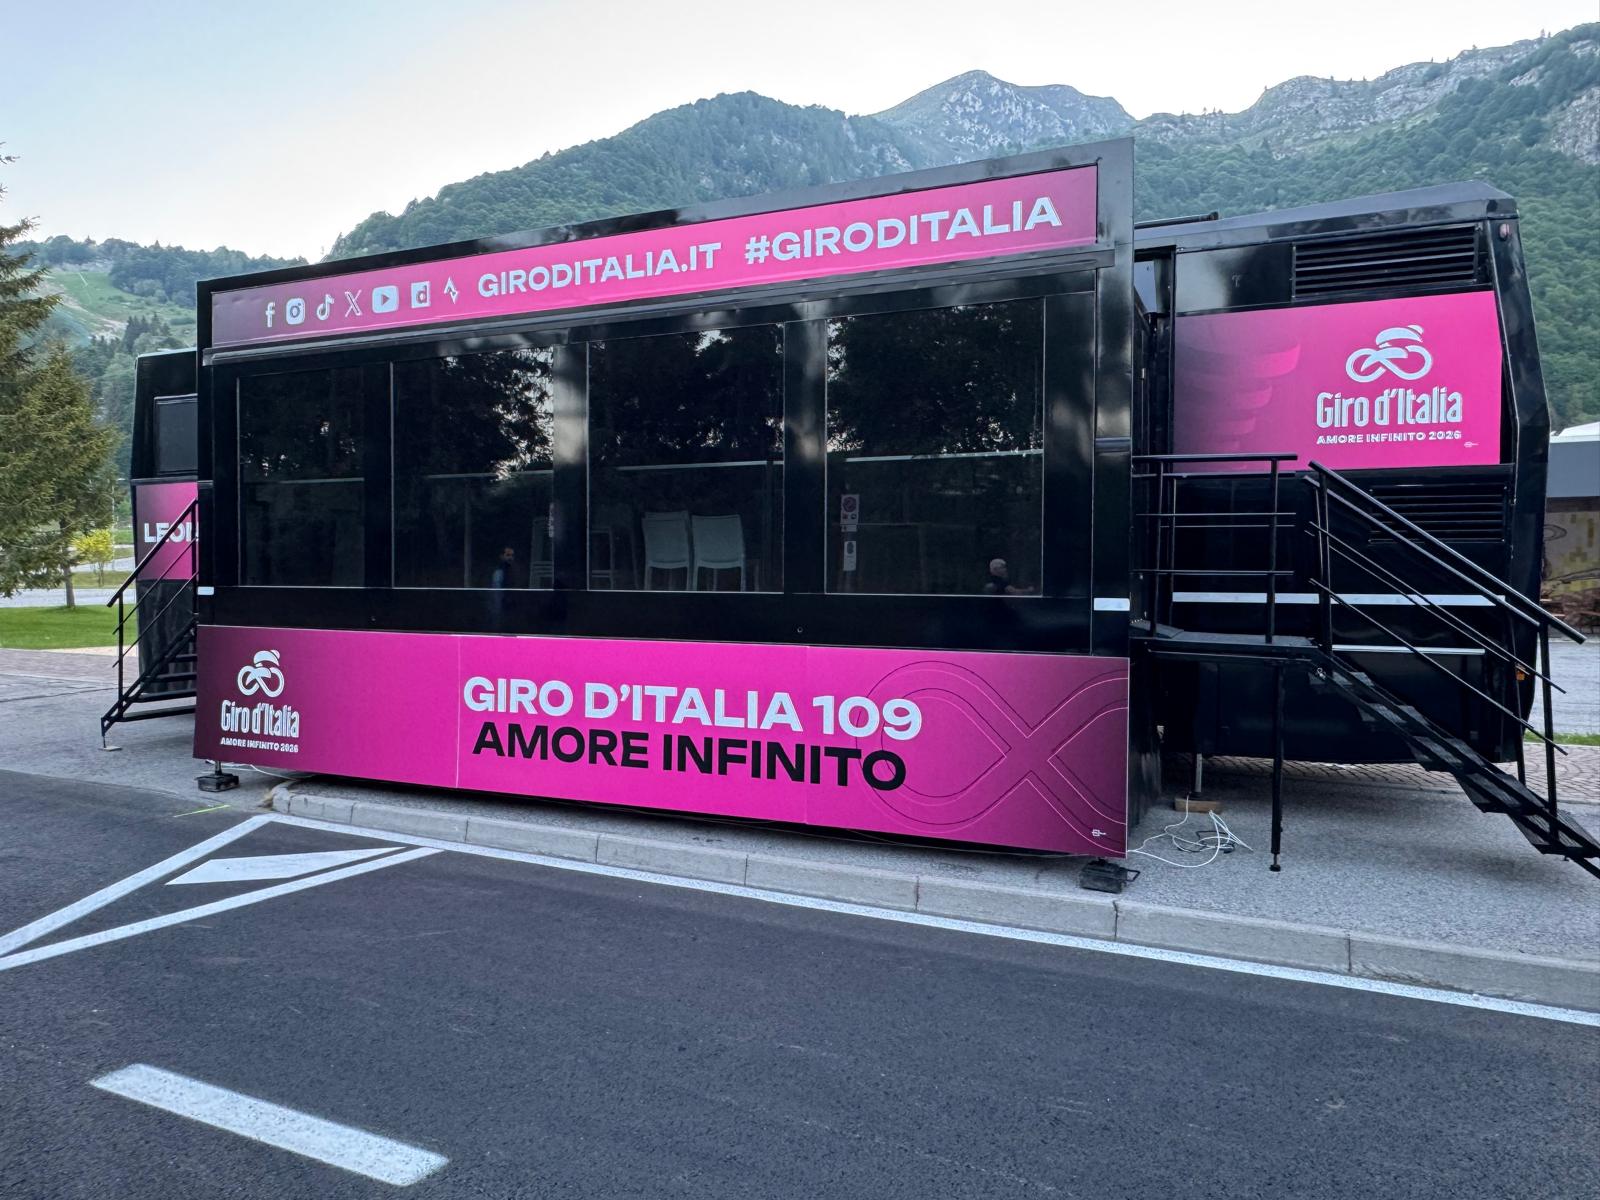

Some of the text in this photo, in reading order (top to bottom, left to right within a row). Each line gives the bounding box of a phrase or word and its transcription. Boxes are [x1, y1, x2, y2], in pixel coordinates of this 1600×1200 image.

[478, 196, 1061, 297] GIRODITALIA.IT #GIRODITALIA
[1316, 386, 1463, 428] Giro d'Italia
[1316, 430, 1462, 445] AMORE INFINITO 2026
[221, 699, 300, 738] Giro d'Italia
[463, 676, 922, 740] GIRO D'ITALIA 109
[220, 737, 299, 753] AMORE INFINITO 2026
[472, 721, 907, 791] AMORE INFINITO
